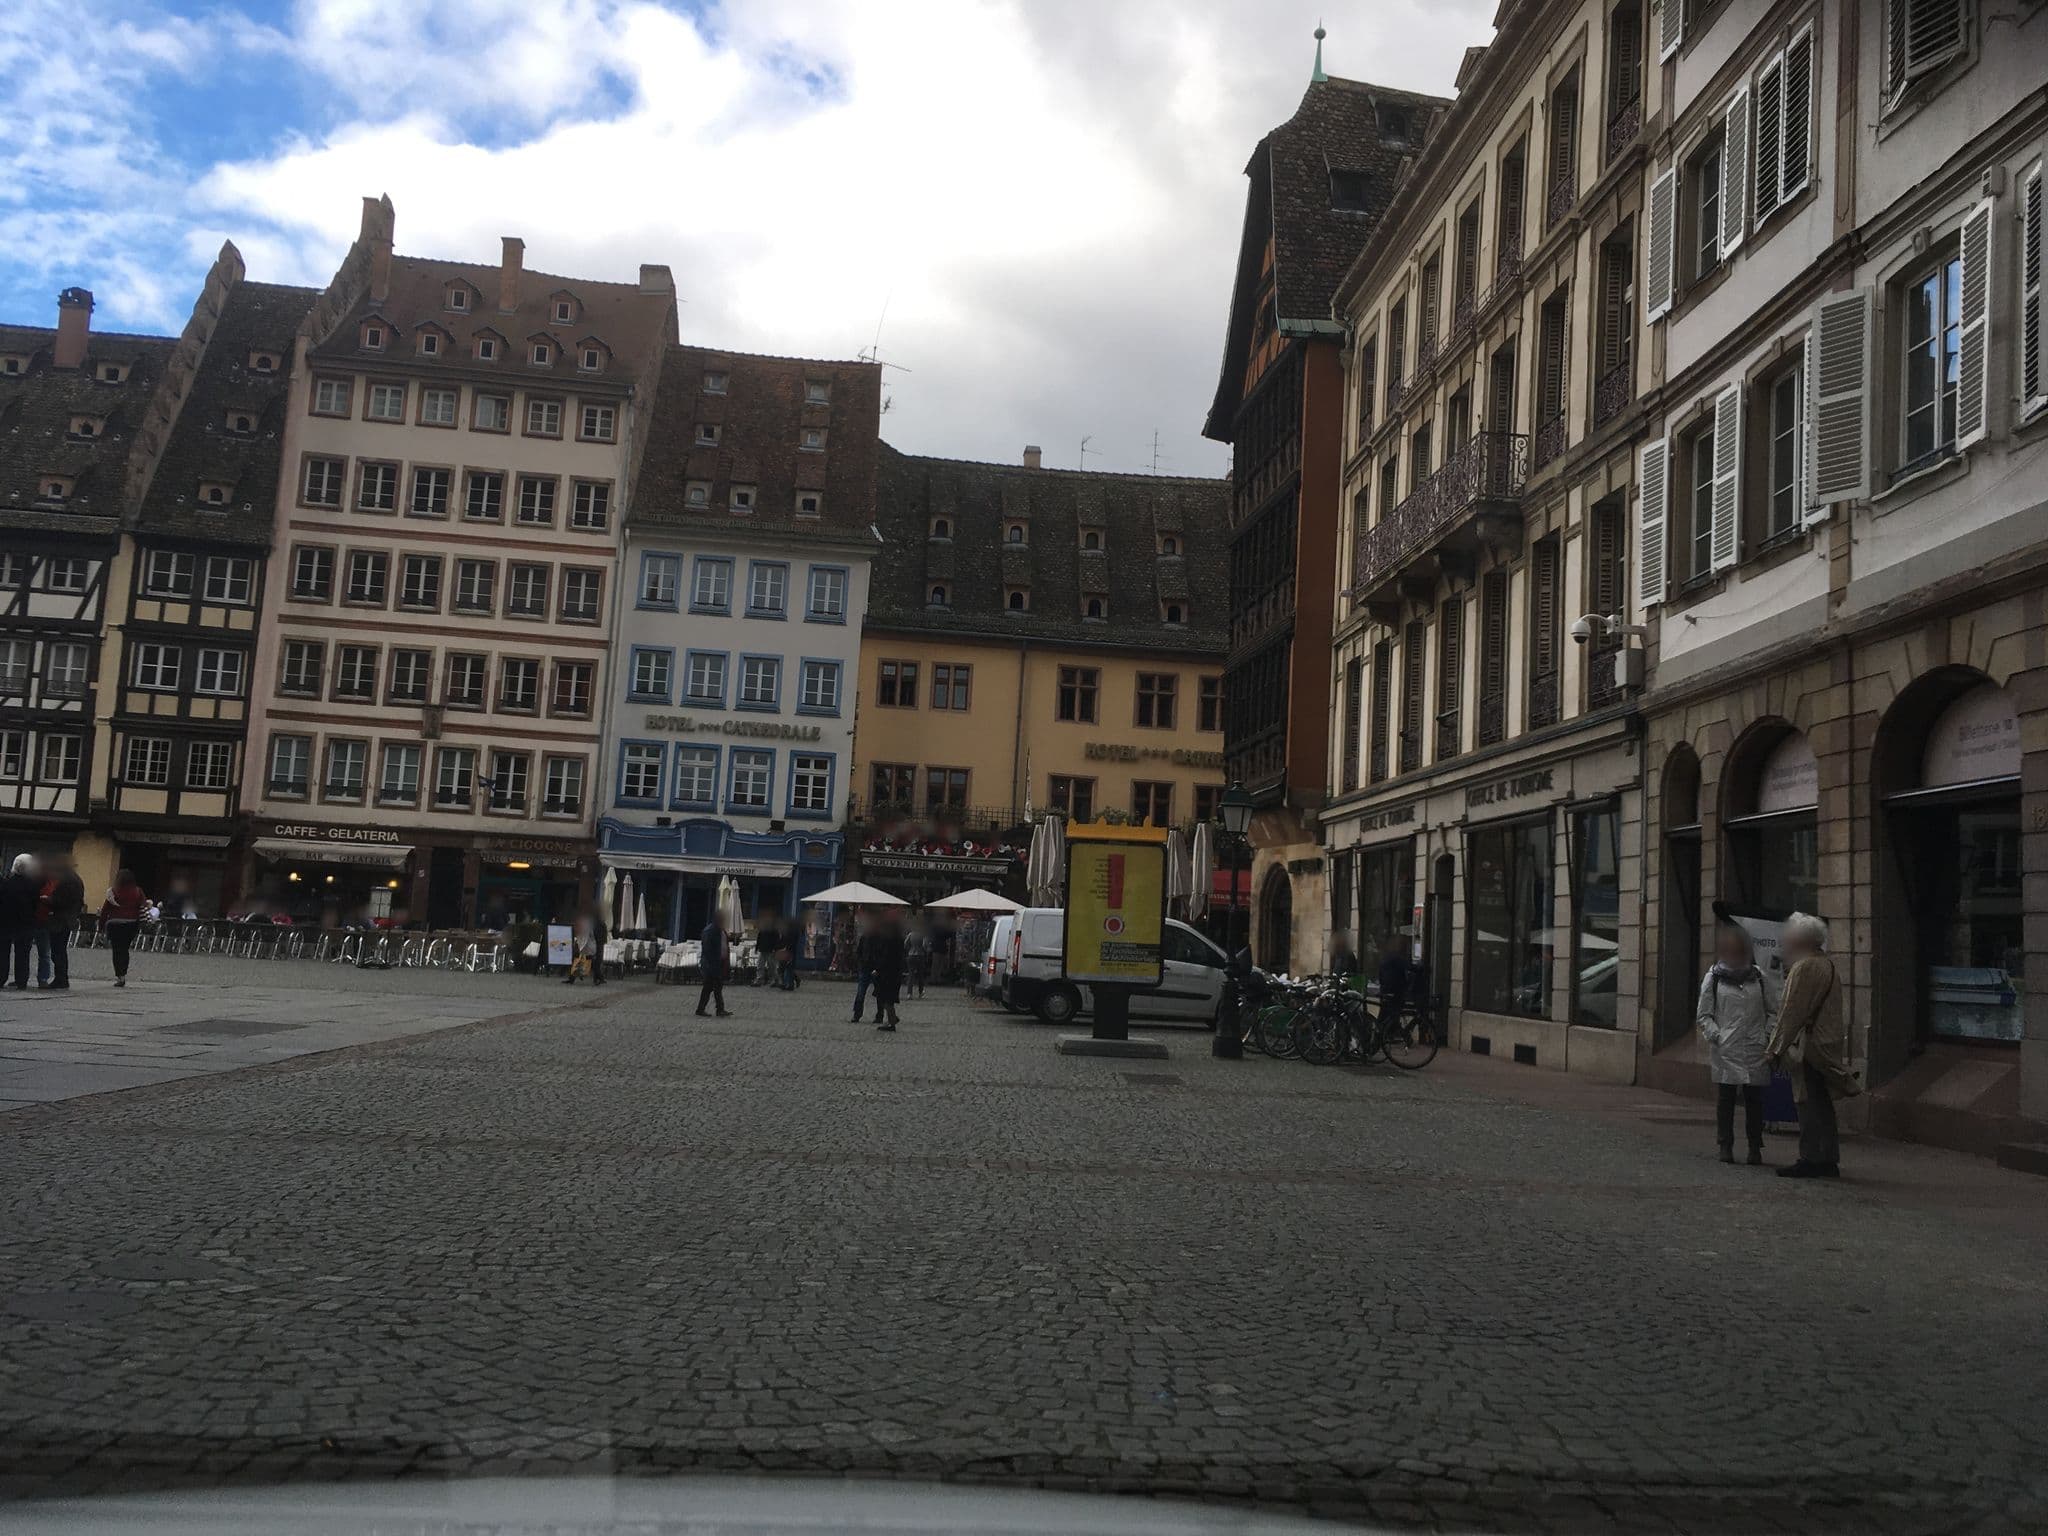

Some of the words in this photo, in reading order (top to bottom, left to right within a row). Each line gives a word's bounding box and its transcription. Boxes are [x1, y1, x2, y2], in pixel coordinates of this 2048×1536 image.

[646, 715, 696, 732] HOTEL
[722, 720, 822, 741] CATHEDRALE
[1085, 743, 1137, 761] HOTEL
[1466, 784, 1495, 807] OFFICE
[1496, 781, 1508, 801] DE
[275, 825, 318, 837] CAFFE
[328, 828, 400, 842] GELATERIA
[306, 851, 324, 860] BAR
[339, 855, 392, 864] GELATERIA
[870, 858, 929, 870] SOUVENIRS
[935, 861, 983, 873] D'ALSACE
[715, 867, 756, 876] BRASSERIE
[1753, 937, 1776, 948] PHOTO
